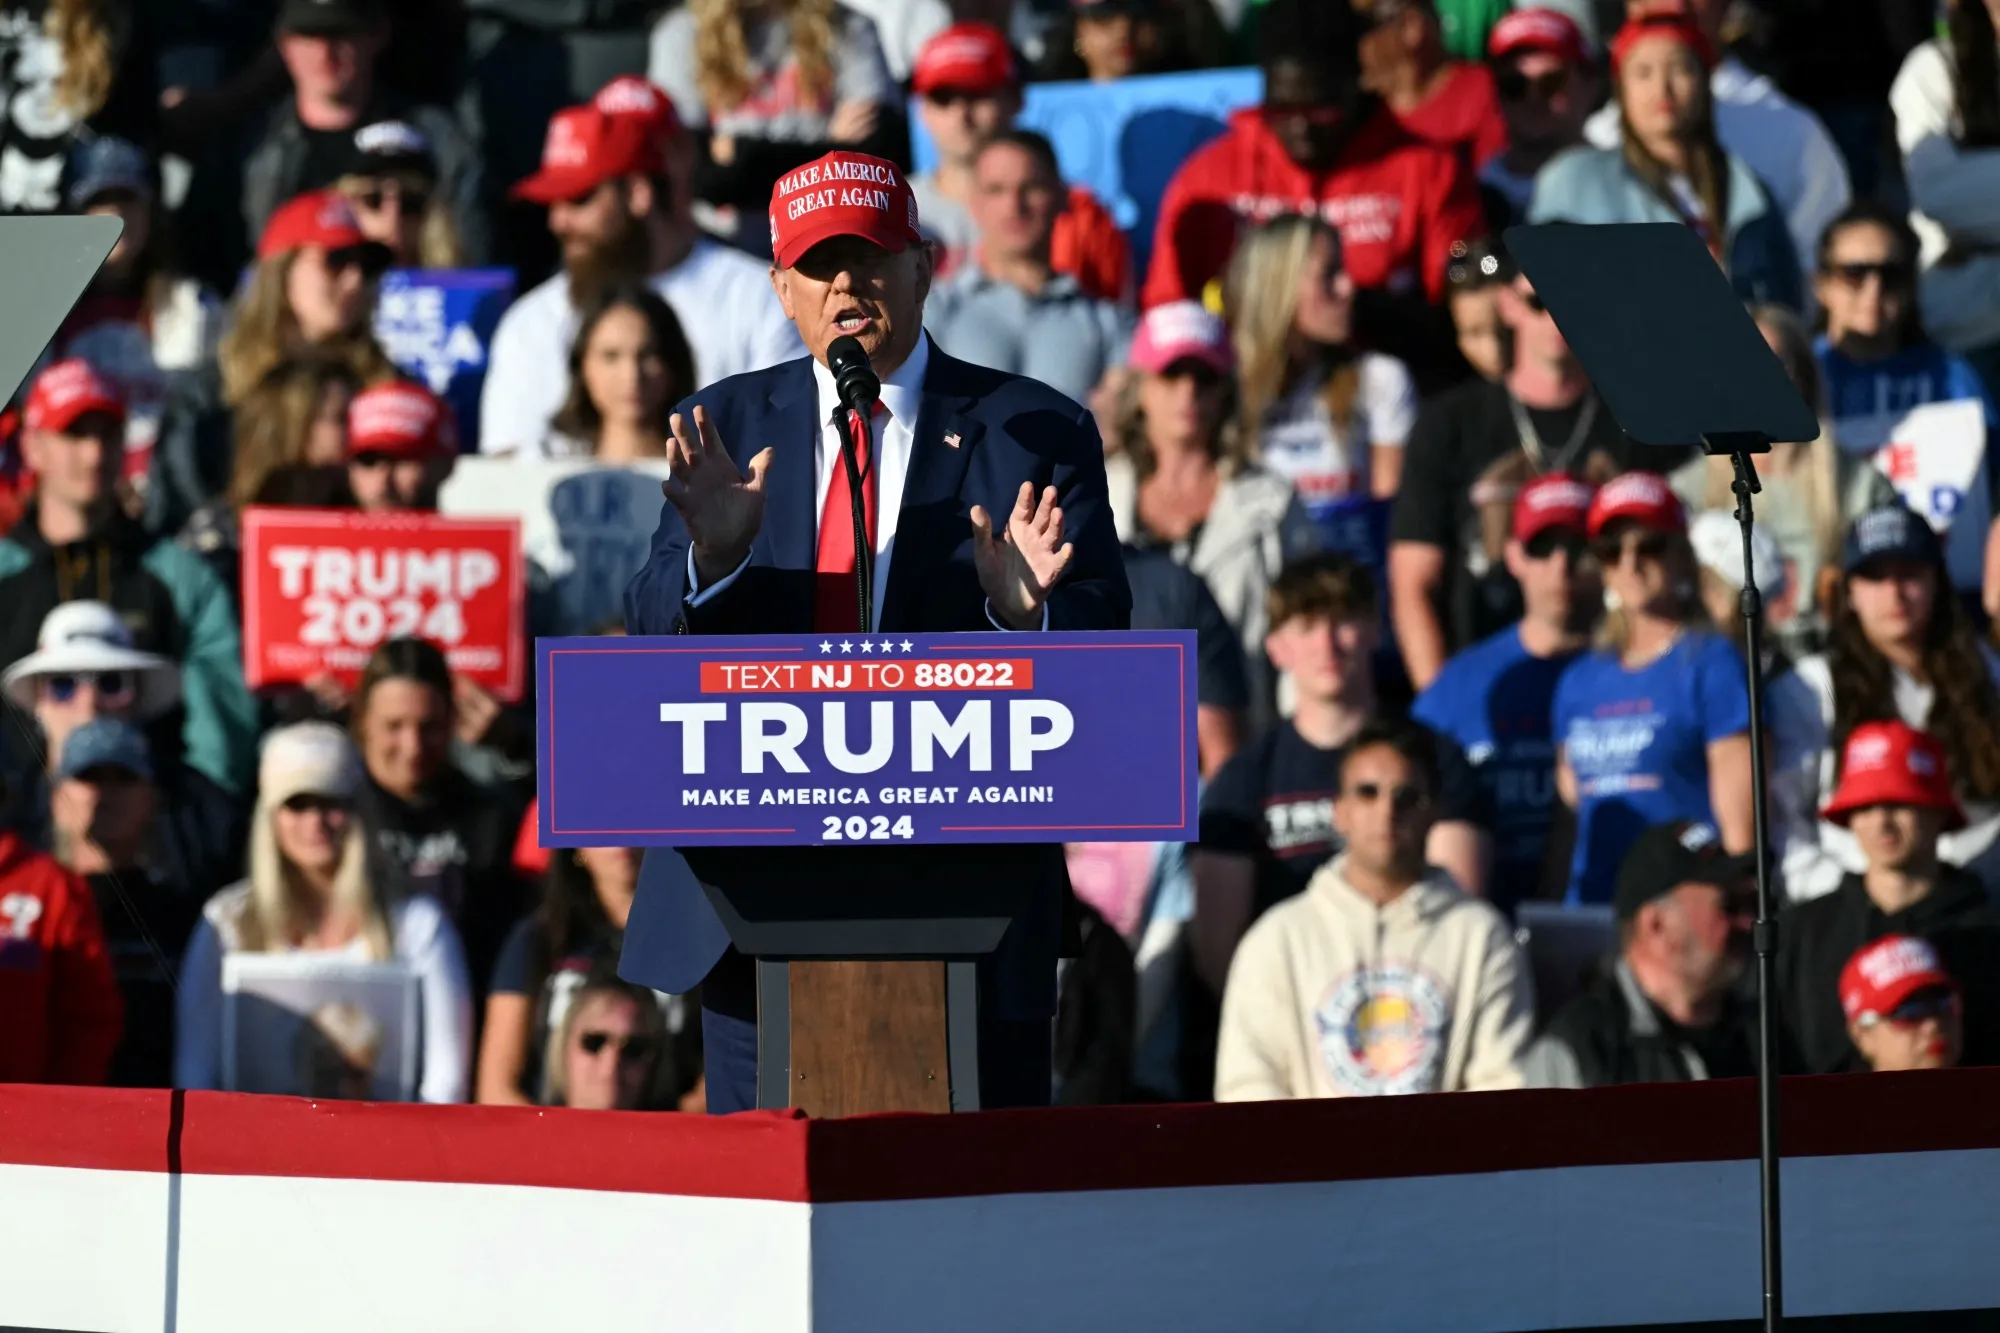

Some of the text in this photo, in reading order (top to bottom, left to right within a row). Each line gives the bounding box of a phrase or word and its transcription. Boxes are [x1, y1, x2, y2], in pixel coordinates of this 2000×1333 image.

[779, 162, 897, 198] MAKE AMERICA
[788, 188, 889, 221] GREAT AGAIN
[270, 546, 497, 598] TRUMP
[301, 598, 466, 646] 2024
[720, 663, 1014, 689] TEXT NJ TO 88022
[660, 699, 1075, 774] TRUMP
[682, 786, 1054, 806] MAKE AMERICA GREAT AGAIN!
[821, 815, 915, 841] 2024
